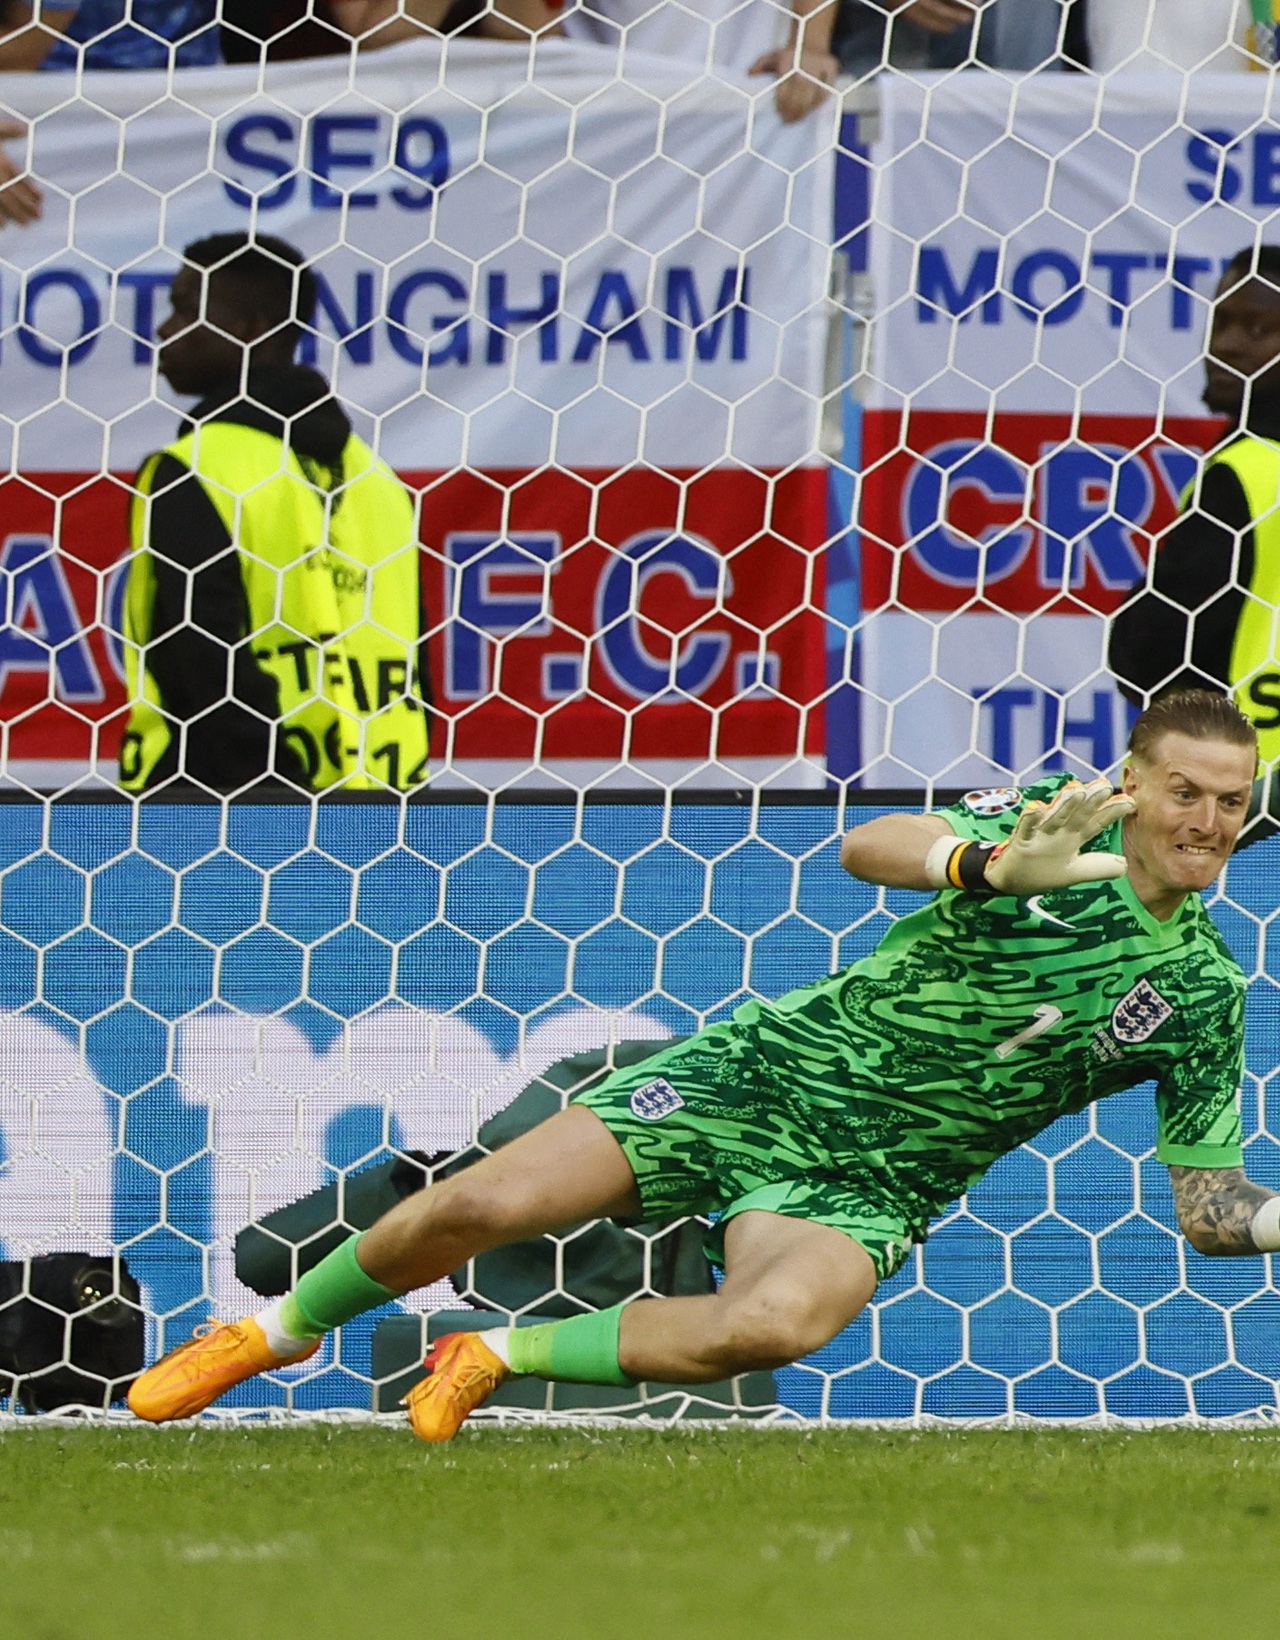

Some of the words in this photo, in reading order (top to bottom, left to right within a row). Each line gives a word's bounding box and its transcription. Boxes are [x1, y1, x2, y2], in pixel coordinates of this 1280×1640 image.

[221, 113, 452, 211] SE9
[8, 267, 750, 368] OTNGHAM
[444, 530, 780, 704] F.C.
[994, 1004, 1063, 1059] 1
